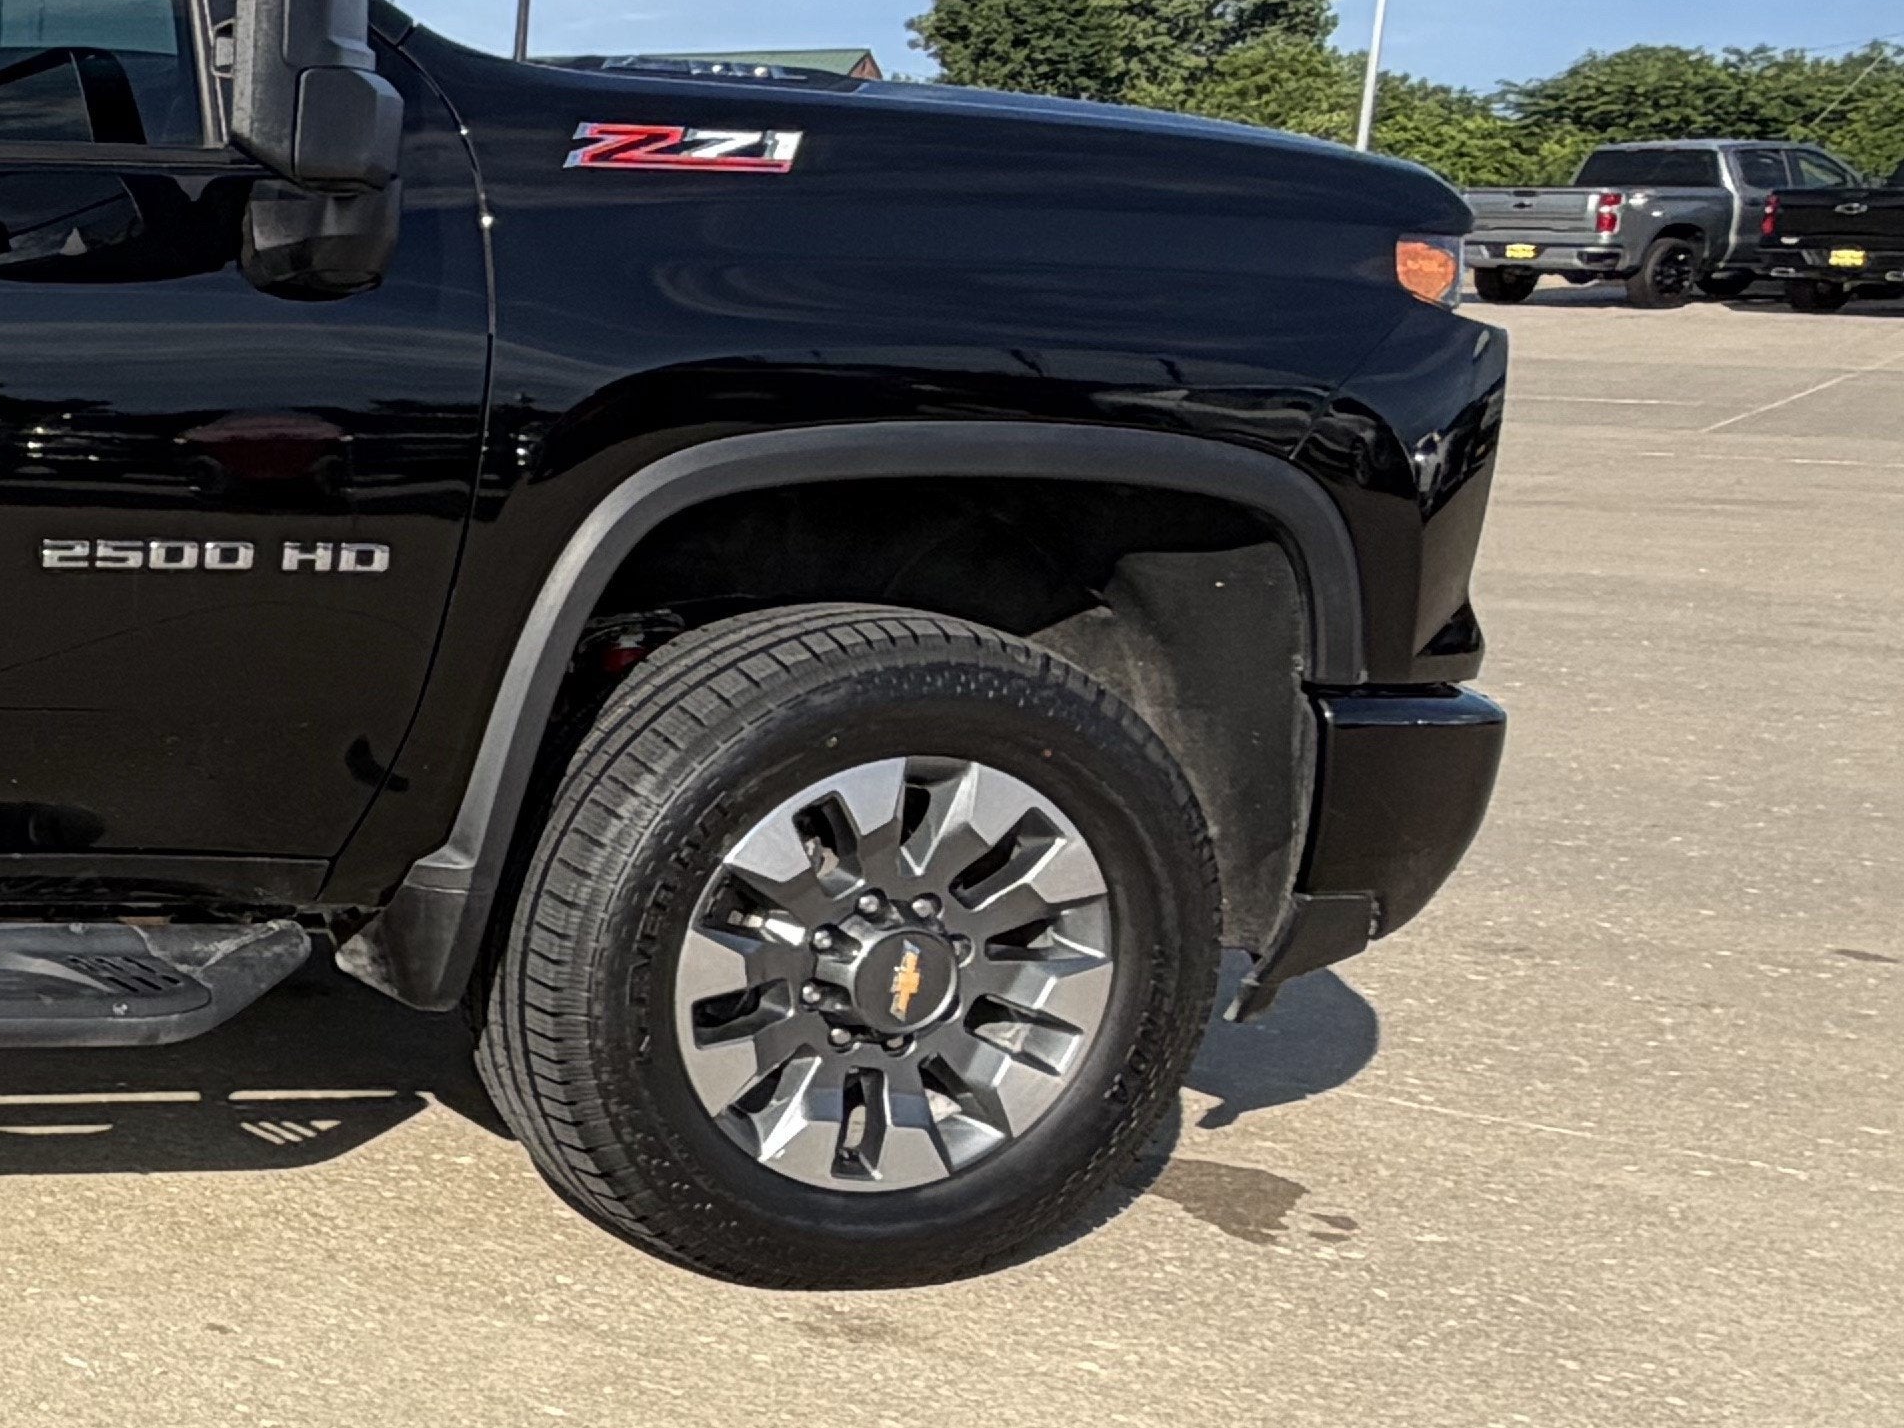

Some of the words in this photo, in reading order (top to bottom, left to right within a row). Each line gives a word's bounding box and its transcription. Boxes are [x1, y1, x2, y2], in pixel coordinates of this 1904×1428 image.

[563, 122, 804, 173] Z71
[41, 538, 255, 570] 2500
[281, 541, 391, 573] HD
